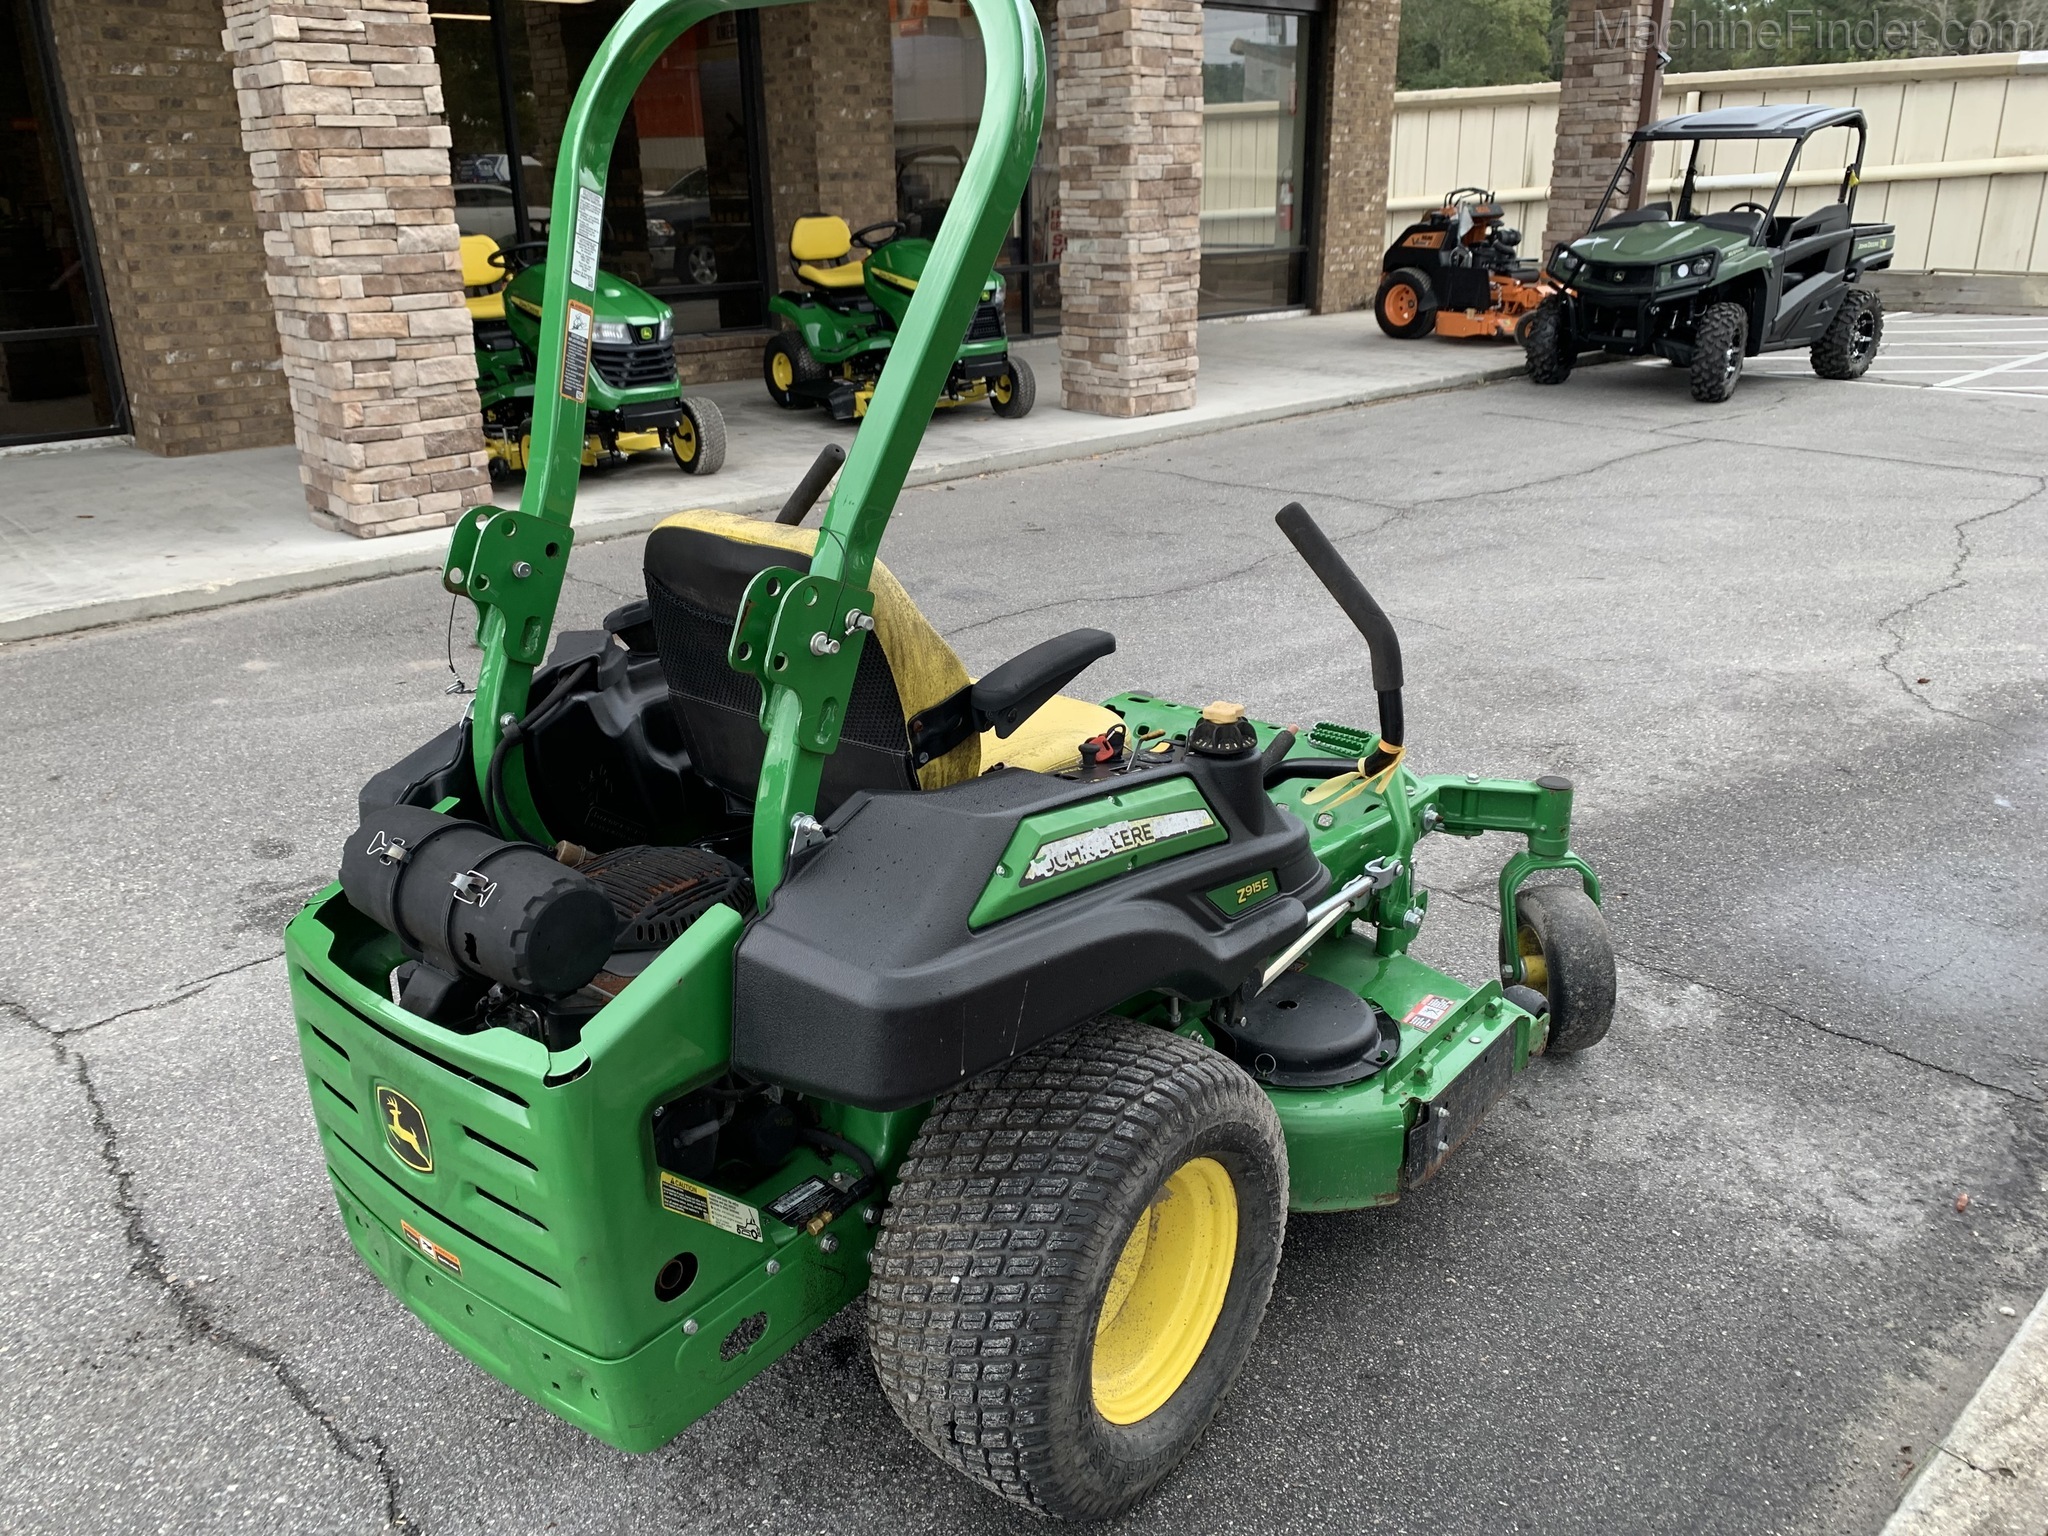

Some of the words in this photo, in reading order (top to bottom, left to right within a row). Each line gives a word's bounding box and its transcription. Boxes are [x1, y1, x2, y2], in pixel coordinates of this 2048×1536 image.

[1099, 823, 1155, 854] EERE
[1236, 877, 1269, 904] Z915E
[674, 1179, 698, 1194] CAUTION
